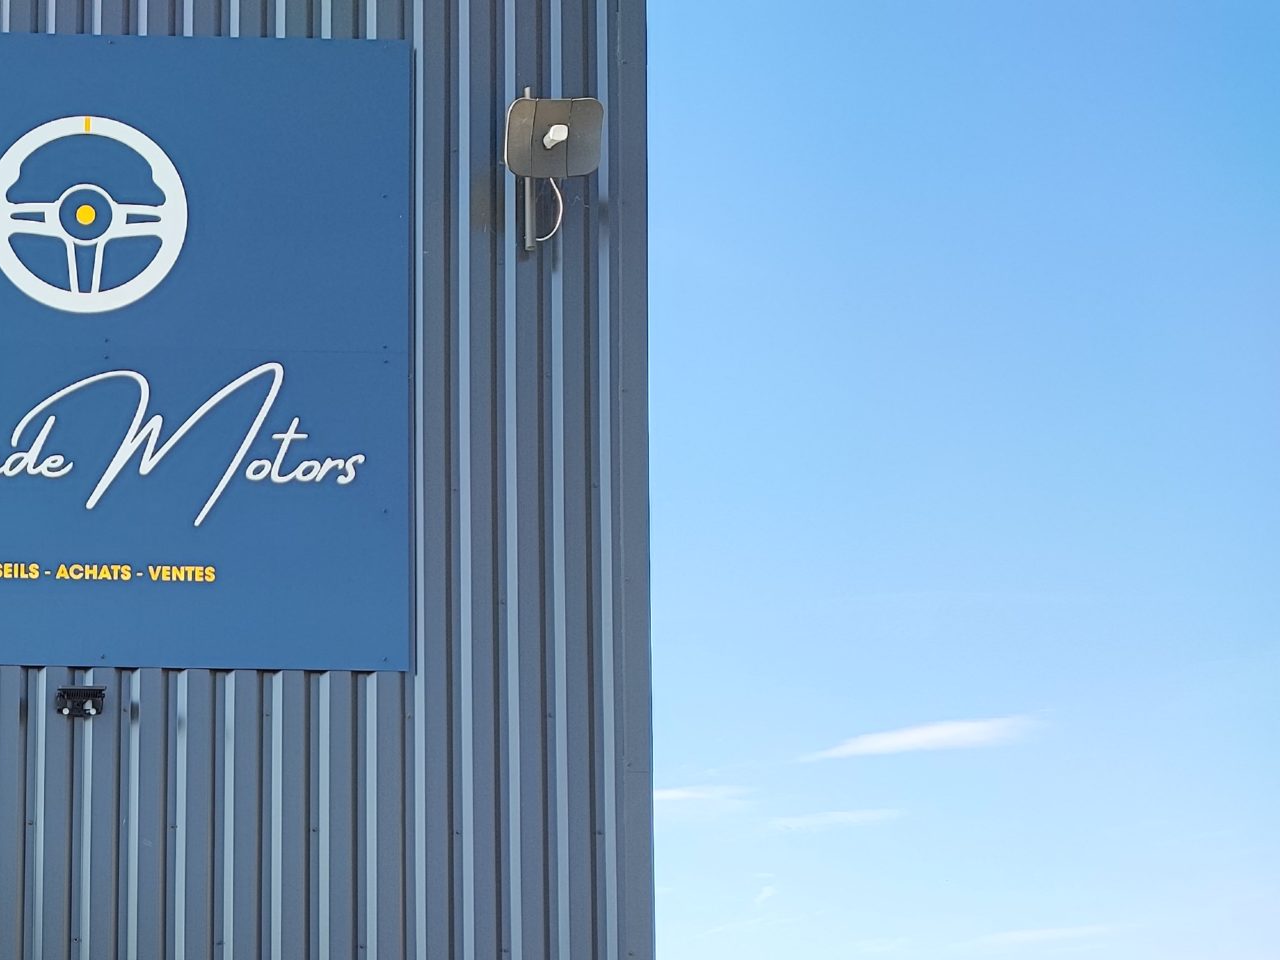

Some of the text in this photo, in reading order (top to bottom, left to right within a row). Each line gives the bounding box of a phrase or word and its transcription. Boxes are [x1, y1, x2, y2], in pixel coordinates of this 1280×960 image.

[11, 362, 366, 527] Motors
[55, 563, 132, 581] ACHATS
[148, 565, 216, 582] VENTES
